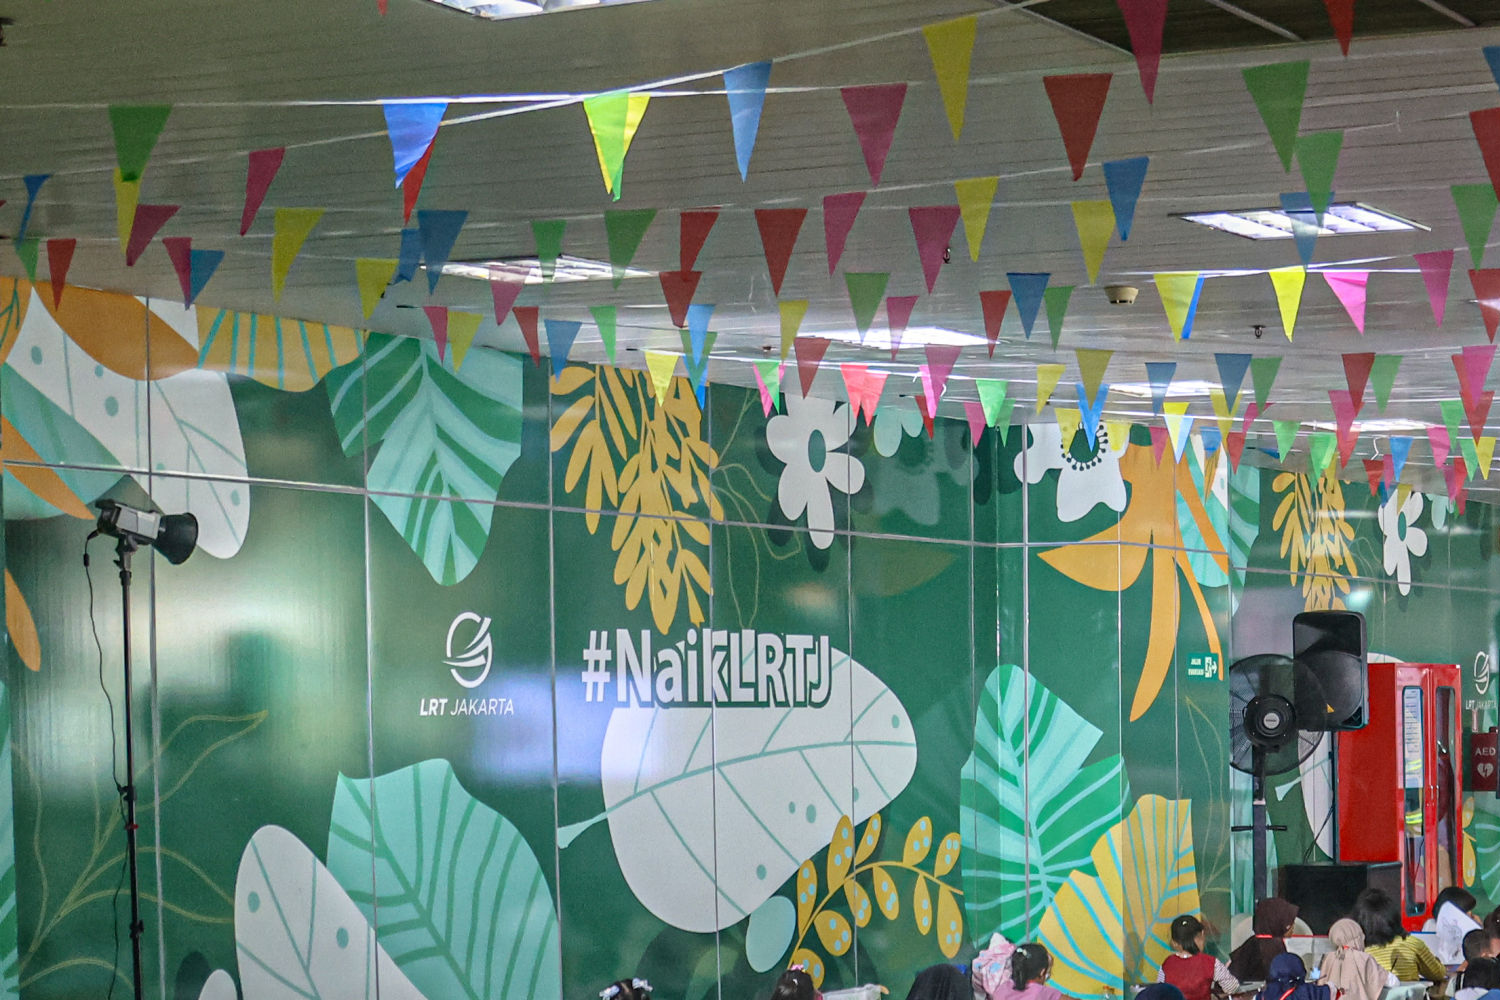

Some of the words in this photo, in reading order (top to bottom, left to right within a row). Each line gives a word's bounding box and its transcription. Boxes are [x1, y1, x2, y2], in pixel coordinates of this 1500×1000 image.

[581, 627, 832, 706] #NaikLRTJ
[419, 699, 448, 716] LRT
[449, 697, 515, 716] JAKARTA
[1475, 747, 1496, 756] AED
